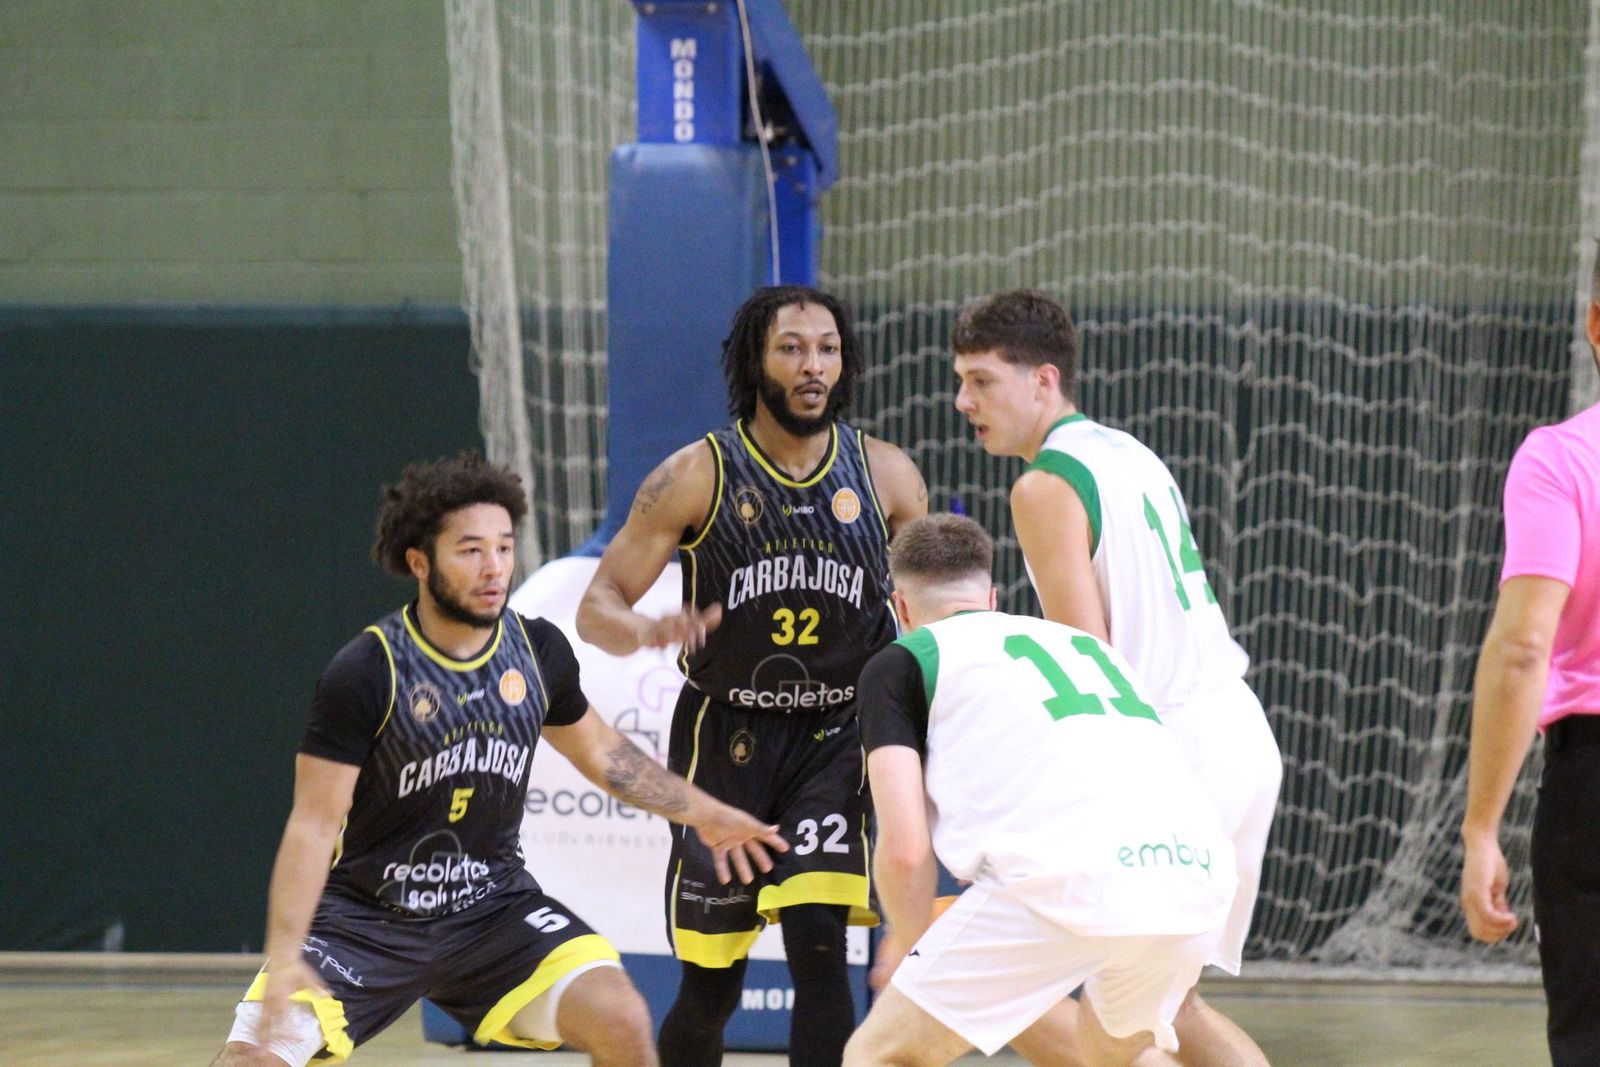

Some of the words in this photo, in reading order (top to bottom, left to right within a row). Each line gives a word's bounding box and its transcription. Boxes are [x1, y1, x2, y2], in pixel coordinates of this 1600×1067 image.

[670, 38, 697, 142] MONDO
[727, 555, 864, 611] CARBAJOSA
[771, 607, 820, 646] 32
[1003, 634, 1163, 726] 11
[398, 738, 529, 799] CARBAJOSA
[449, 788, 474, 823] 5
[794, 813, 850, 856] 32
[1118, 834, 1211, 879] emby
[523, 906, 570, 934] 5
